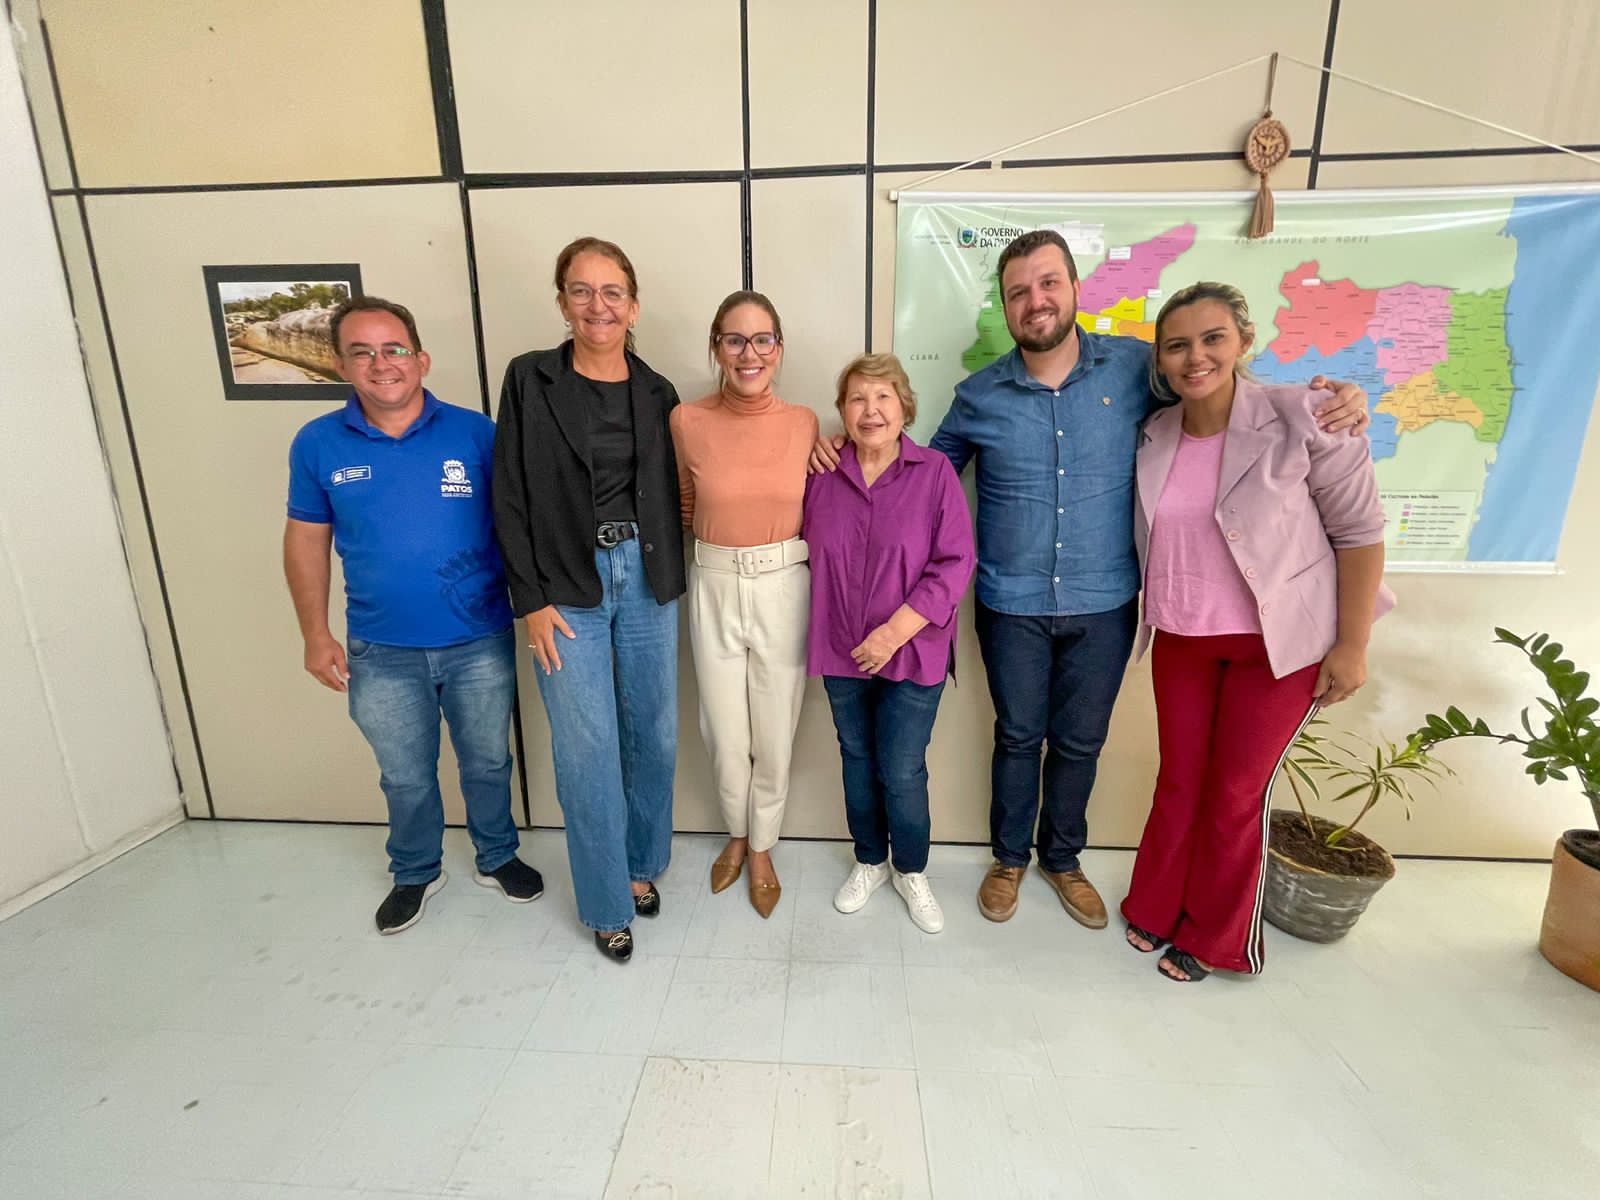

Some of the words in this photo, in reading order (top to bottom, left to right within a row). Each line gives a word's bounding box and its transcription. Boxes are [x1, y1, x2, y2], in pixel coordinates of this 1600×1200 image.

[980, 227, 1024, 237] GOVERNO
[980, 238, 993, 248] DA
[1335, 235, 1369, 244] NORTE
[440, 484, 473, 494] PATOS
